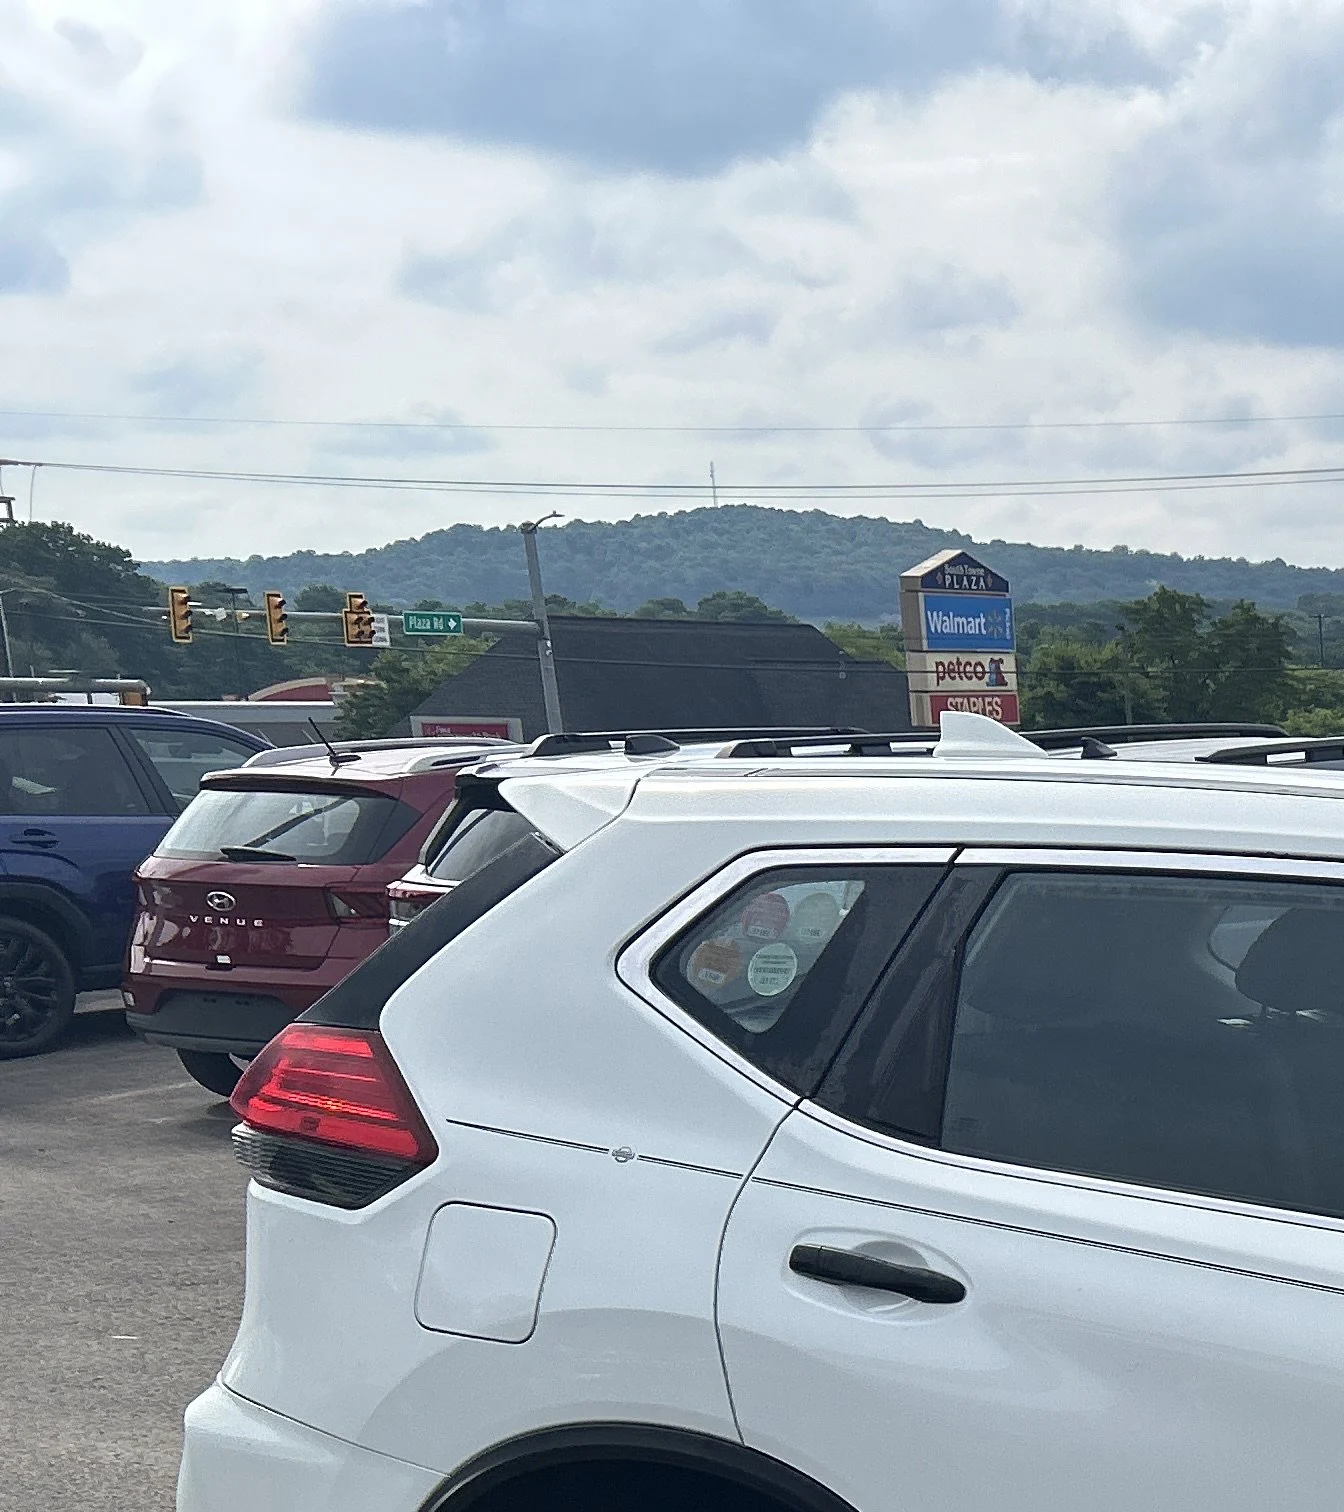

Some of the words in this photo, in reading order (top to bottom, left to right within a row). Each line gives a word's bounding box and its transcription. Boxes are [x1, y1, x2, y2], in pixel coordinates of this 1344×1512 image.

[944, 575, 985, 589] PLAZA
[408, 615, 431, 629] Plaza
[433, 617, 444, 630] Rd
[927, 610, 987, 634] Walmart
[935, 656, 986, 686] petco
[946, 697, 1002, 720] STAPLES
[189, 914, 264, 927] VENUE
